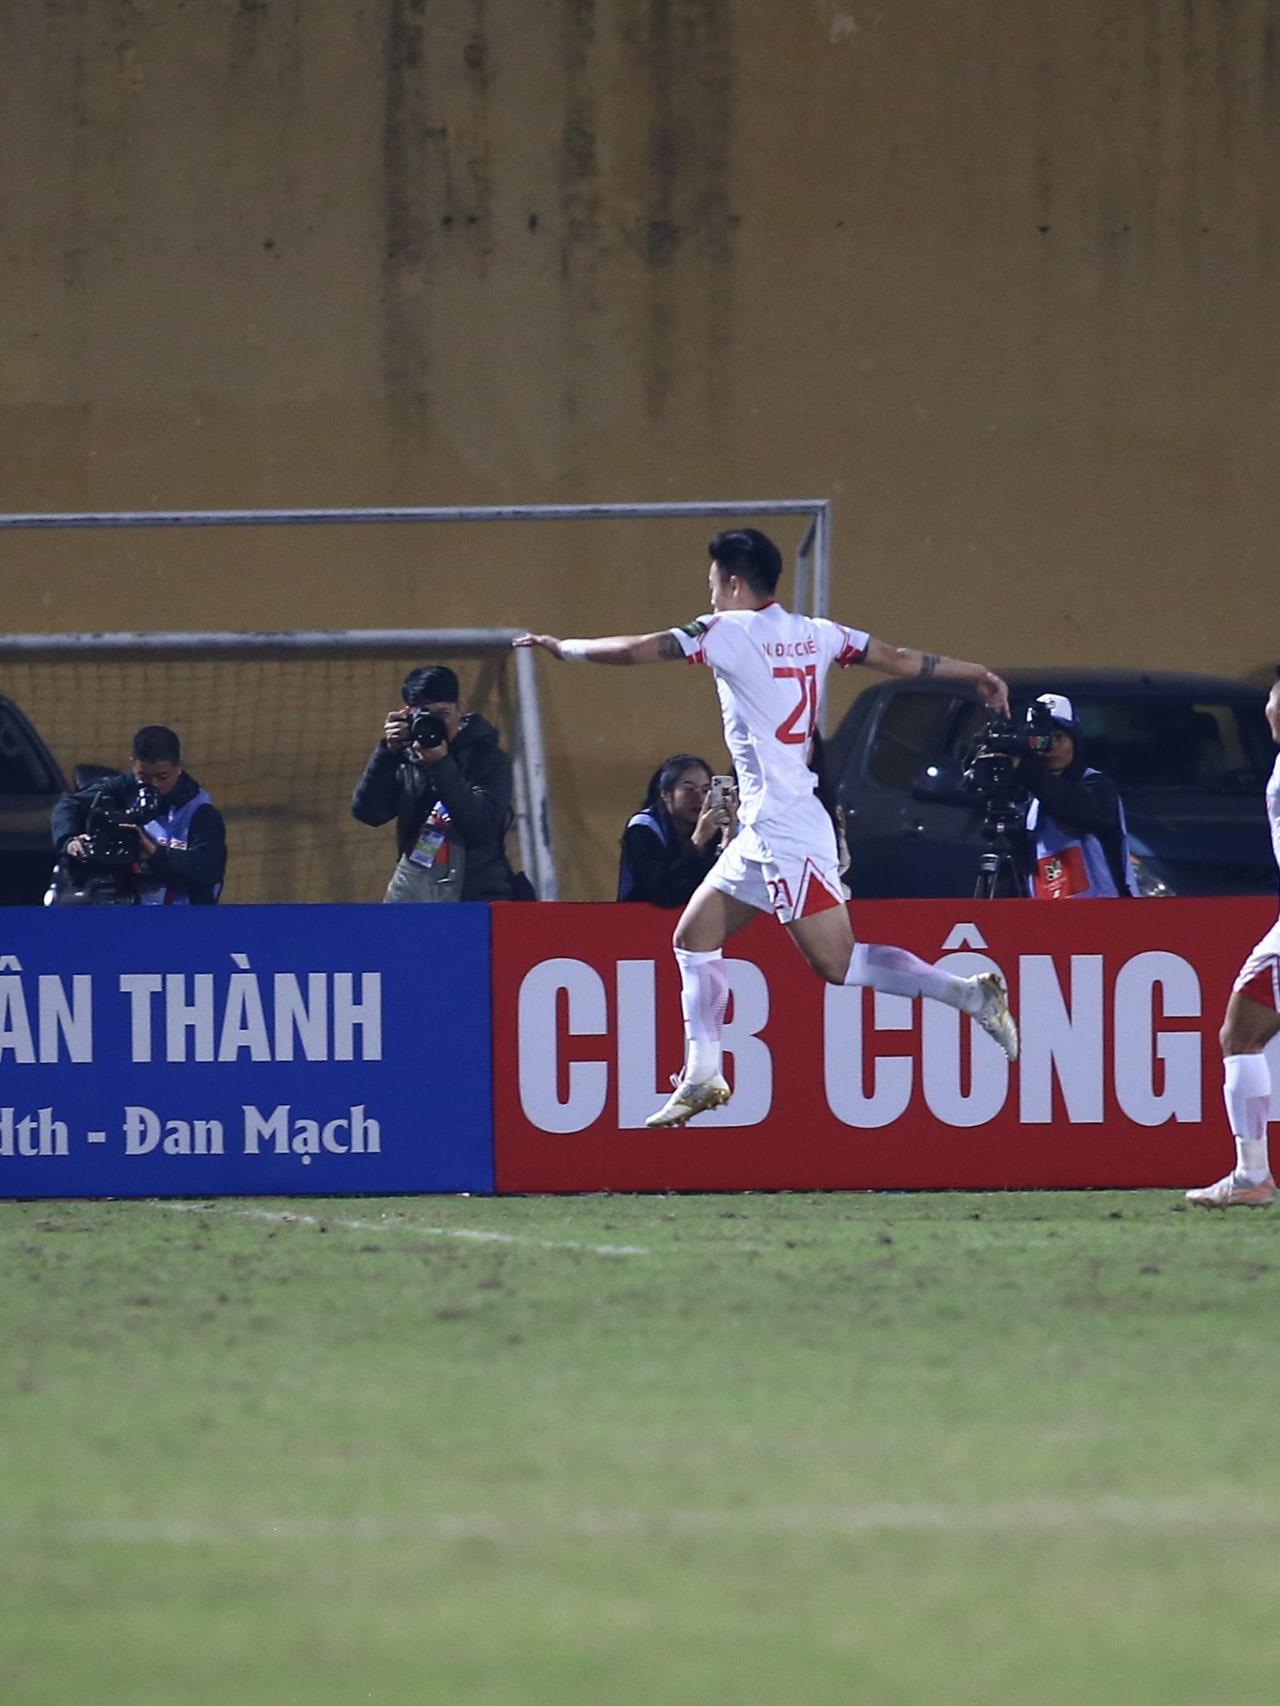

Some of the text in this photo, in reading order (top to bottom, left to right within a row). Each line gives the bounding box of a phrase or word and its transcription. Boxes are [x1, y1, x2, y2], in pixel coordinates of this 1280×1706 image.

[772, 664, 816, 745] 21
[0, 953, 382, 1064] ÂN THÀNH
[518, 957, 774, 1134] CLB
[824, 922, 1202, 1129] CÔNG
[87, 1131, 106, 1143] -
[122, 1106, 224, 1156] Đan
[242, 1104, 381, 1165] Mạch
